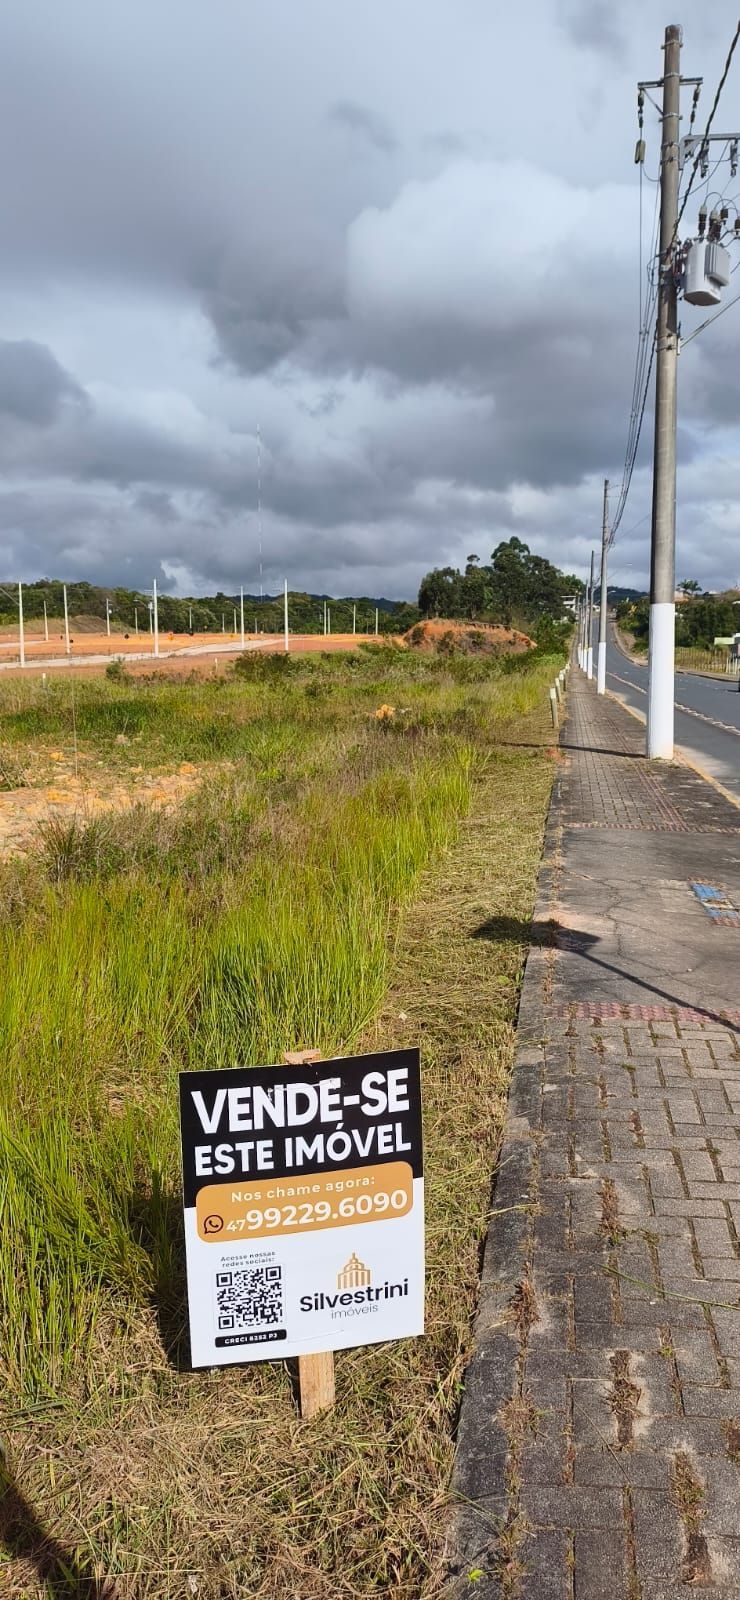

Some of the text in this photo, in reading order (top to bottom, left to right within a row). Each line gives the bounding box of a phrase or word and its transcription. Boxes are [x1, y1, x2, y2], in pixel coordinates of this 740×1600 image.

[191, 1068, 410, 1134] VENDE-SE
[194, 1122, 412, 1177] ESTE IMÓVEL
[231, 1176, 376, 1203] Nos chame agora:
[300, 1278, 409, 1312] Silvestrini
[331, 1303, 379, 1320] imóveis
